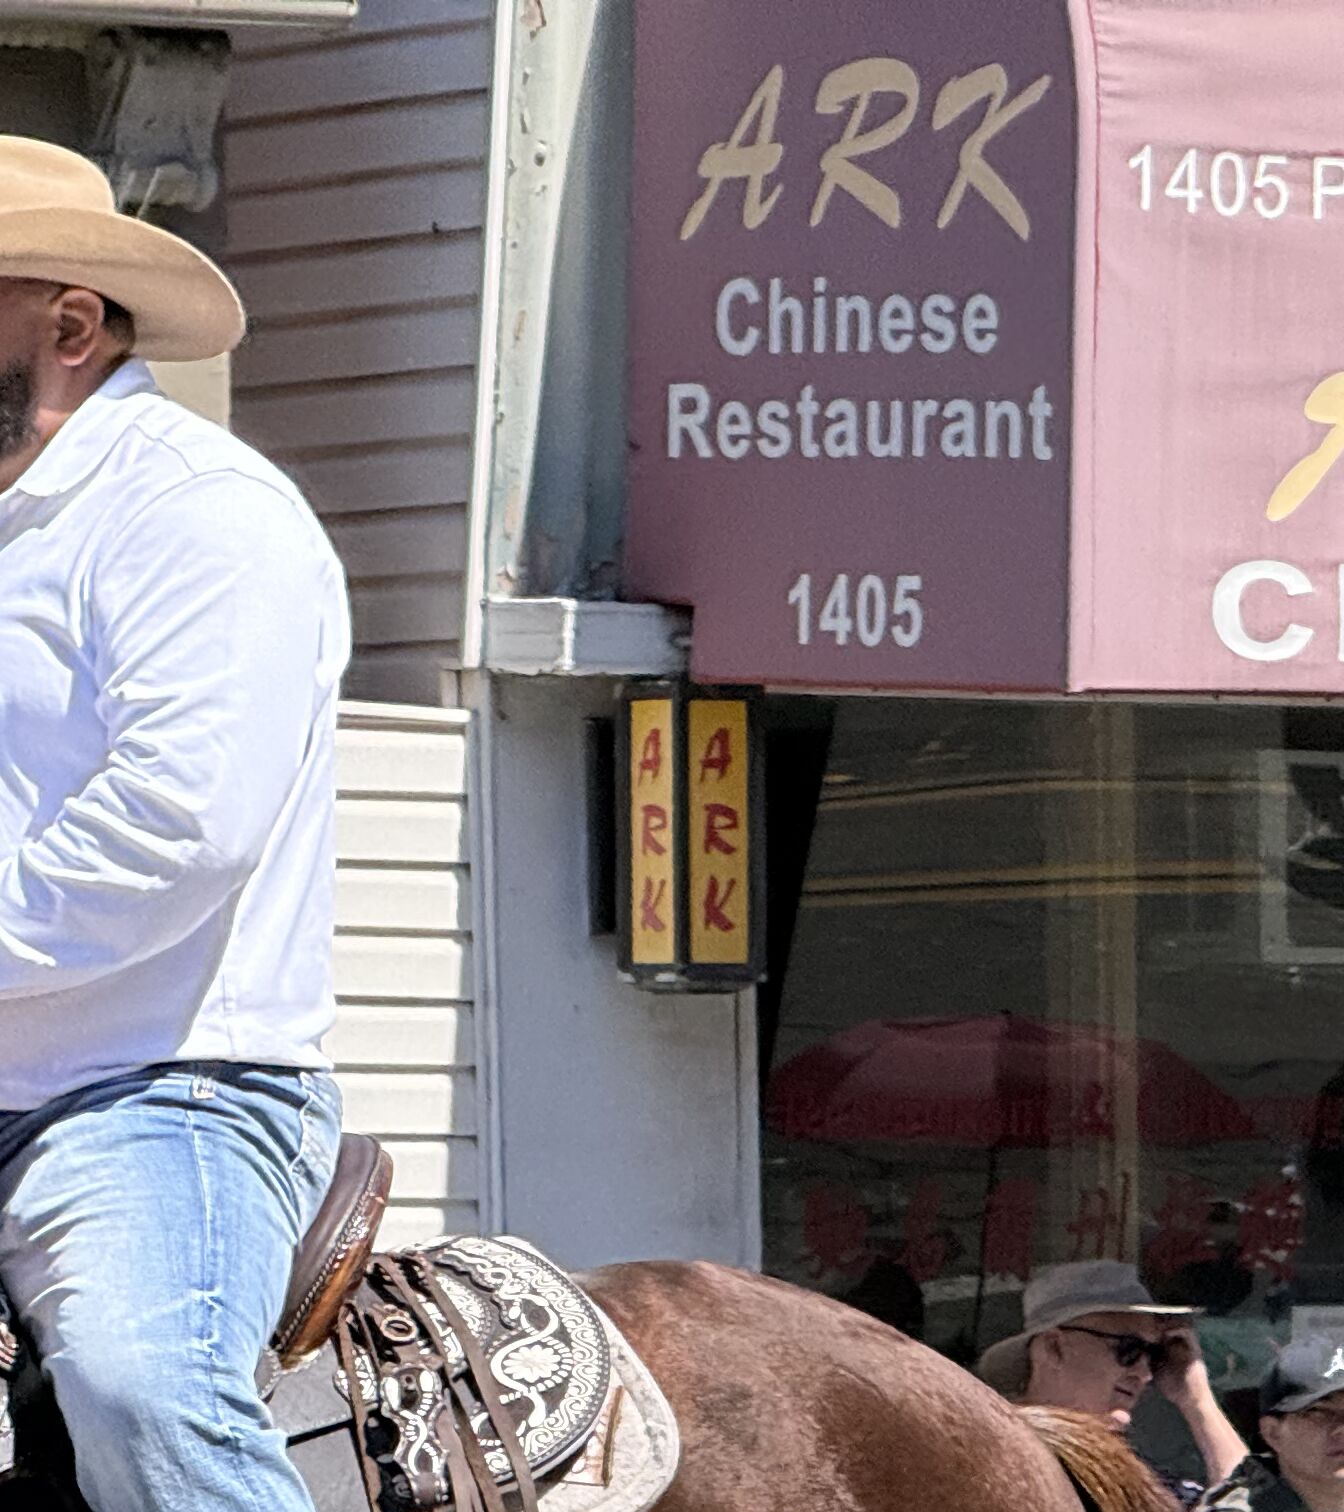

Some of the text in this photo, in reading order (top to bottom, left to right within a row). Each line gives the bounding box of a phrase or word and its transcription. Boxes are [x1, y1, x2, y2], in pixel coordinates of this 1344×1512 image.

[679, 57, 1053, 242] ARK
[1126, 146, 1291, 221] 1405
[715, 276, 1000, 357] Chinese
[666, 382, 1054, 461] Restaurant
[787, 573, 925, 649] 1405
[1212, 559, 1344, 662] C
[637, 727, 668, 932] ARK
[699, 726, 739, 932] ARK
